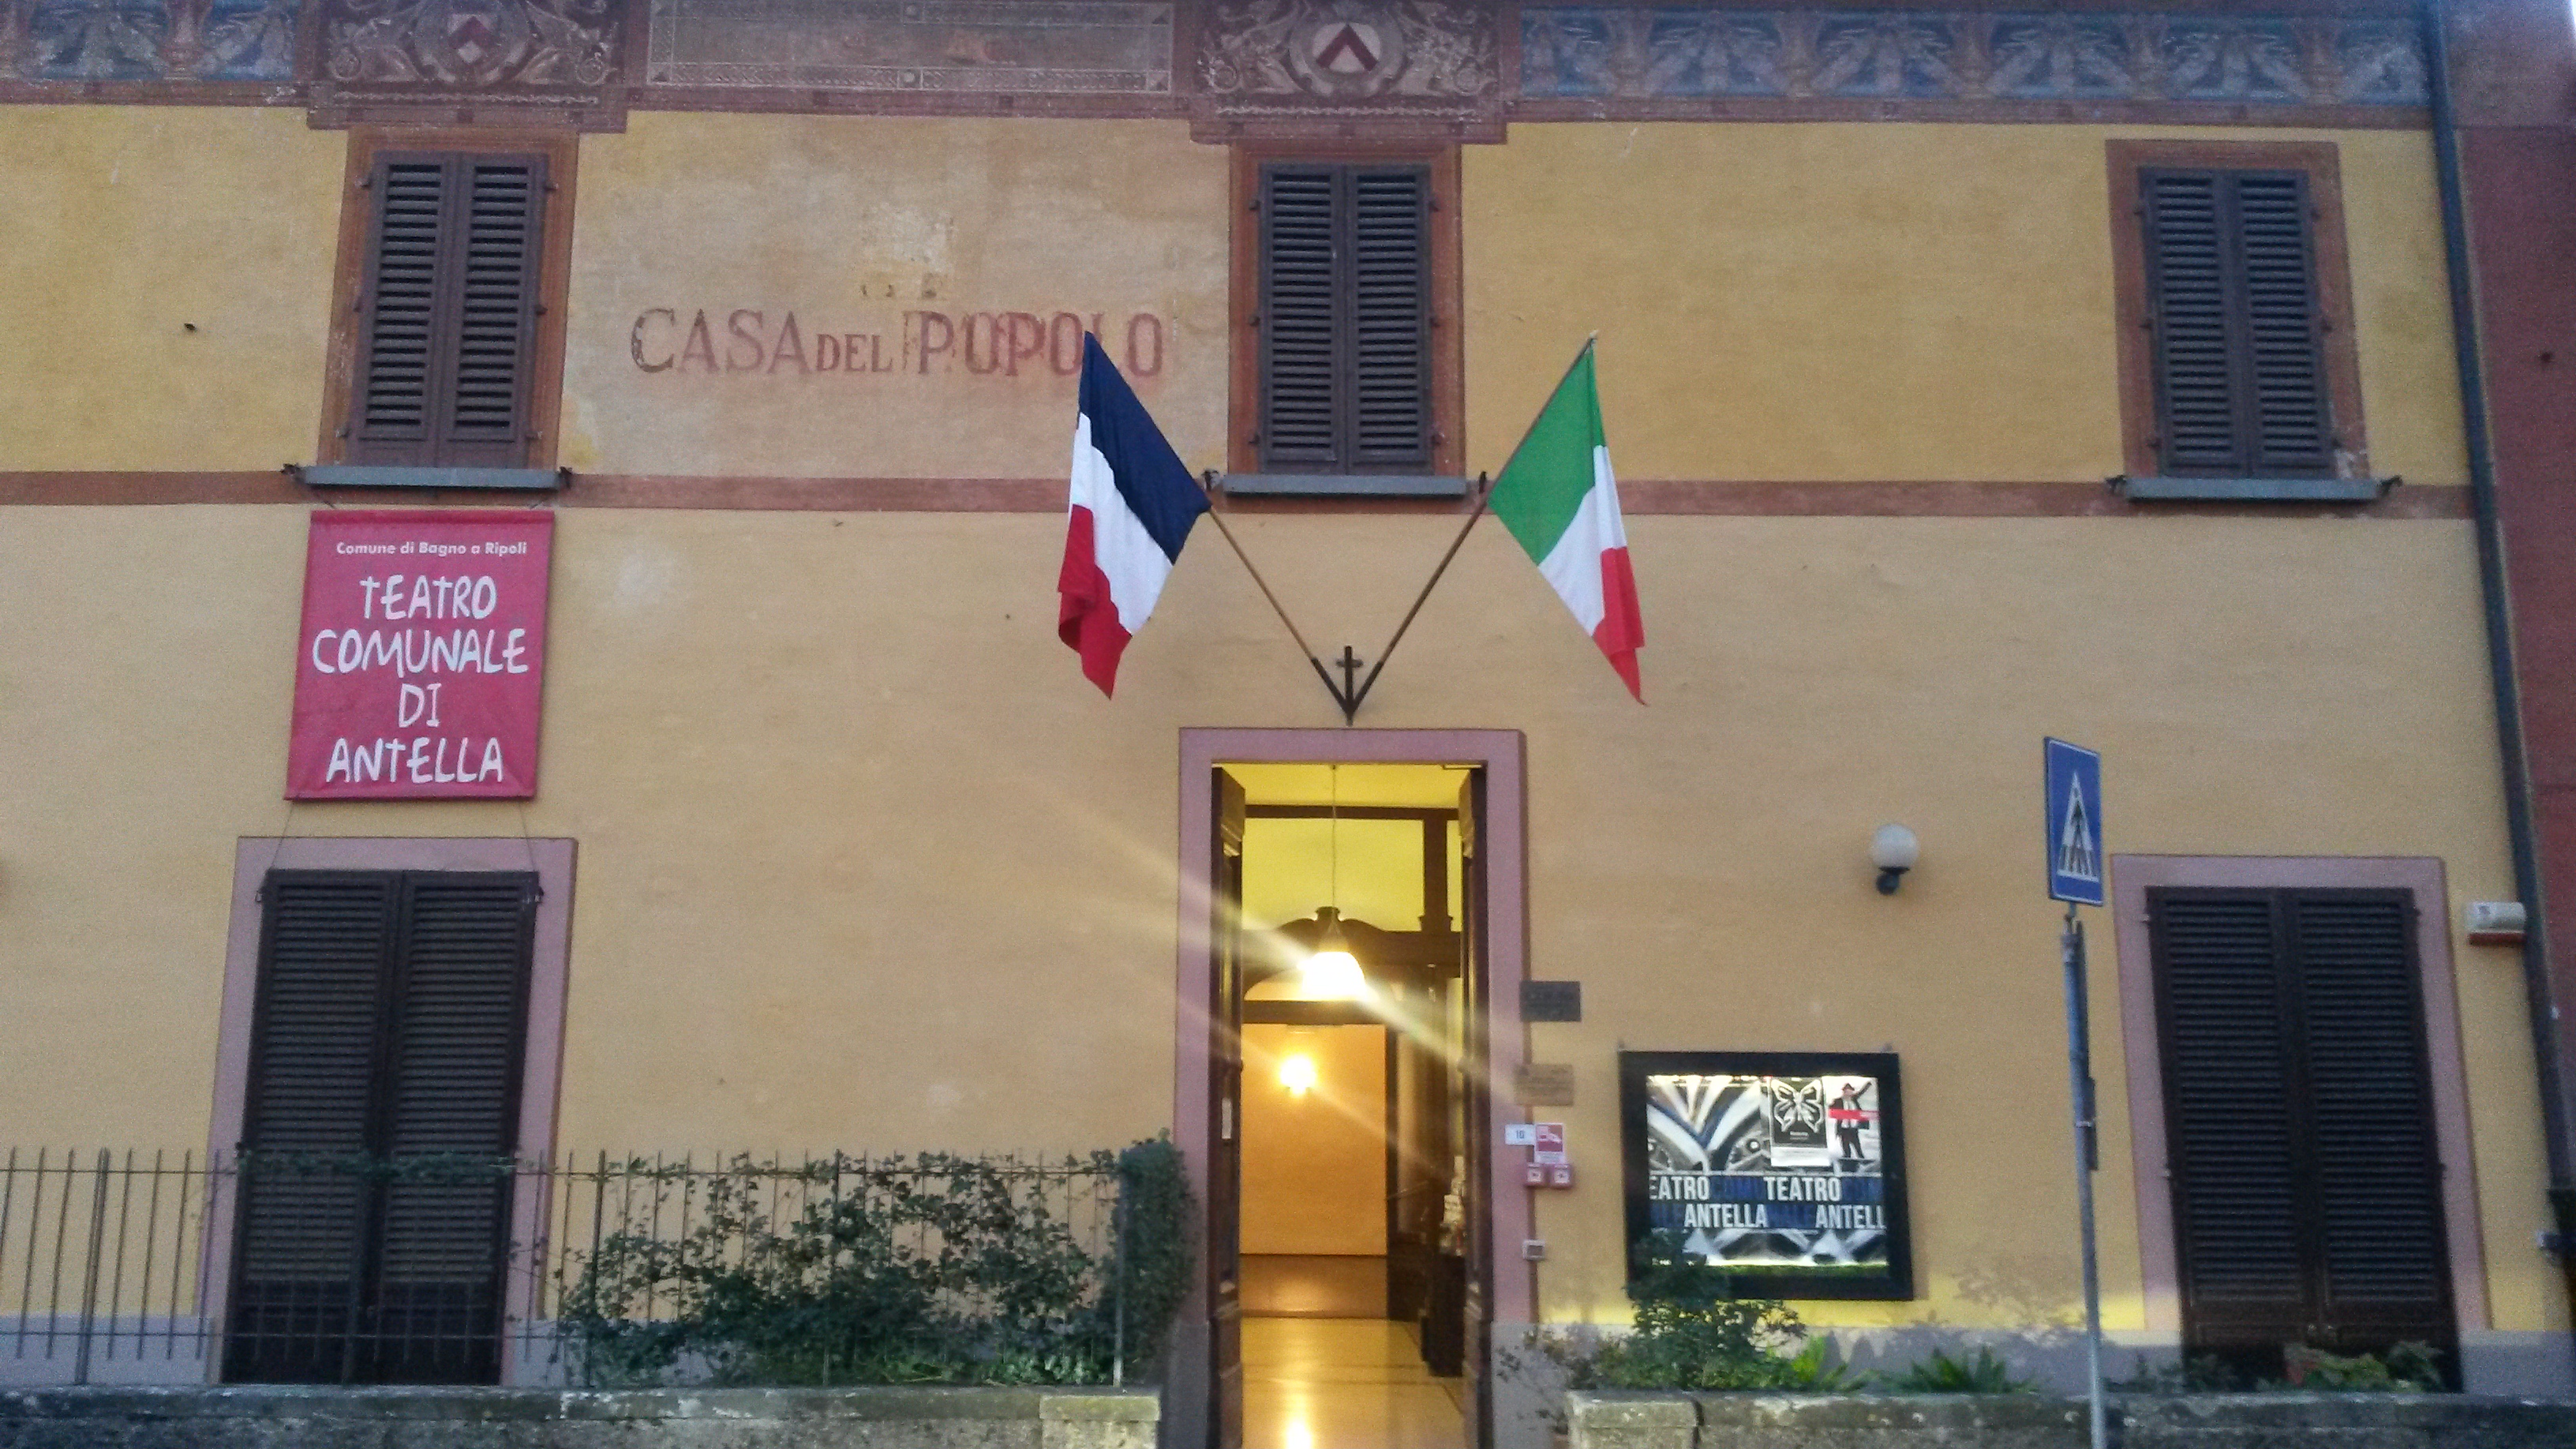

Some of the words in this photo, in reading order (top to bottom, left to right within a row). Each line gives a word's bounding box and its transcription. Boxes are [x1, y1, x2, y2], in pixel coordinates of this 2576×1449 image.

[631, 308, 812, 375] CASA
[816, 333, 893, 373] DEL
[336, 541, 395, 554] Comune
[400, 541, 414, 554] di
[418, 541, 466, 556] Bagno
[471, 544, 481, 554] a
[485, 541, 527, 556] Ripoli
[359, 575, 497, 620] TEATRO
[313, 628, 529, 678] COMUNALE
[398, 683, 442, 728] DI
[326, 736, 504, 784] ANTELLA
[1763, 1176, 1842, 1201] TEATRO
[1683, 1204, 1769, 1228] ANTELLA
